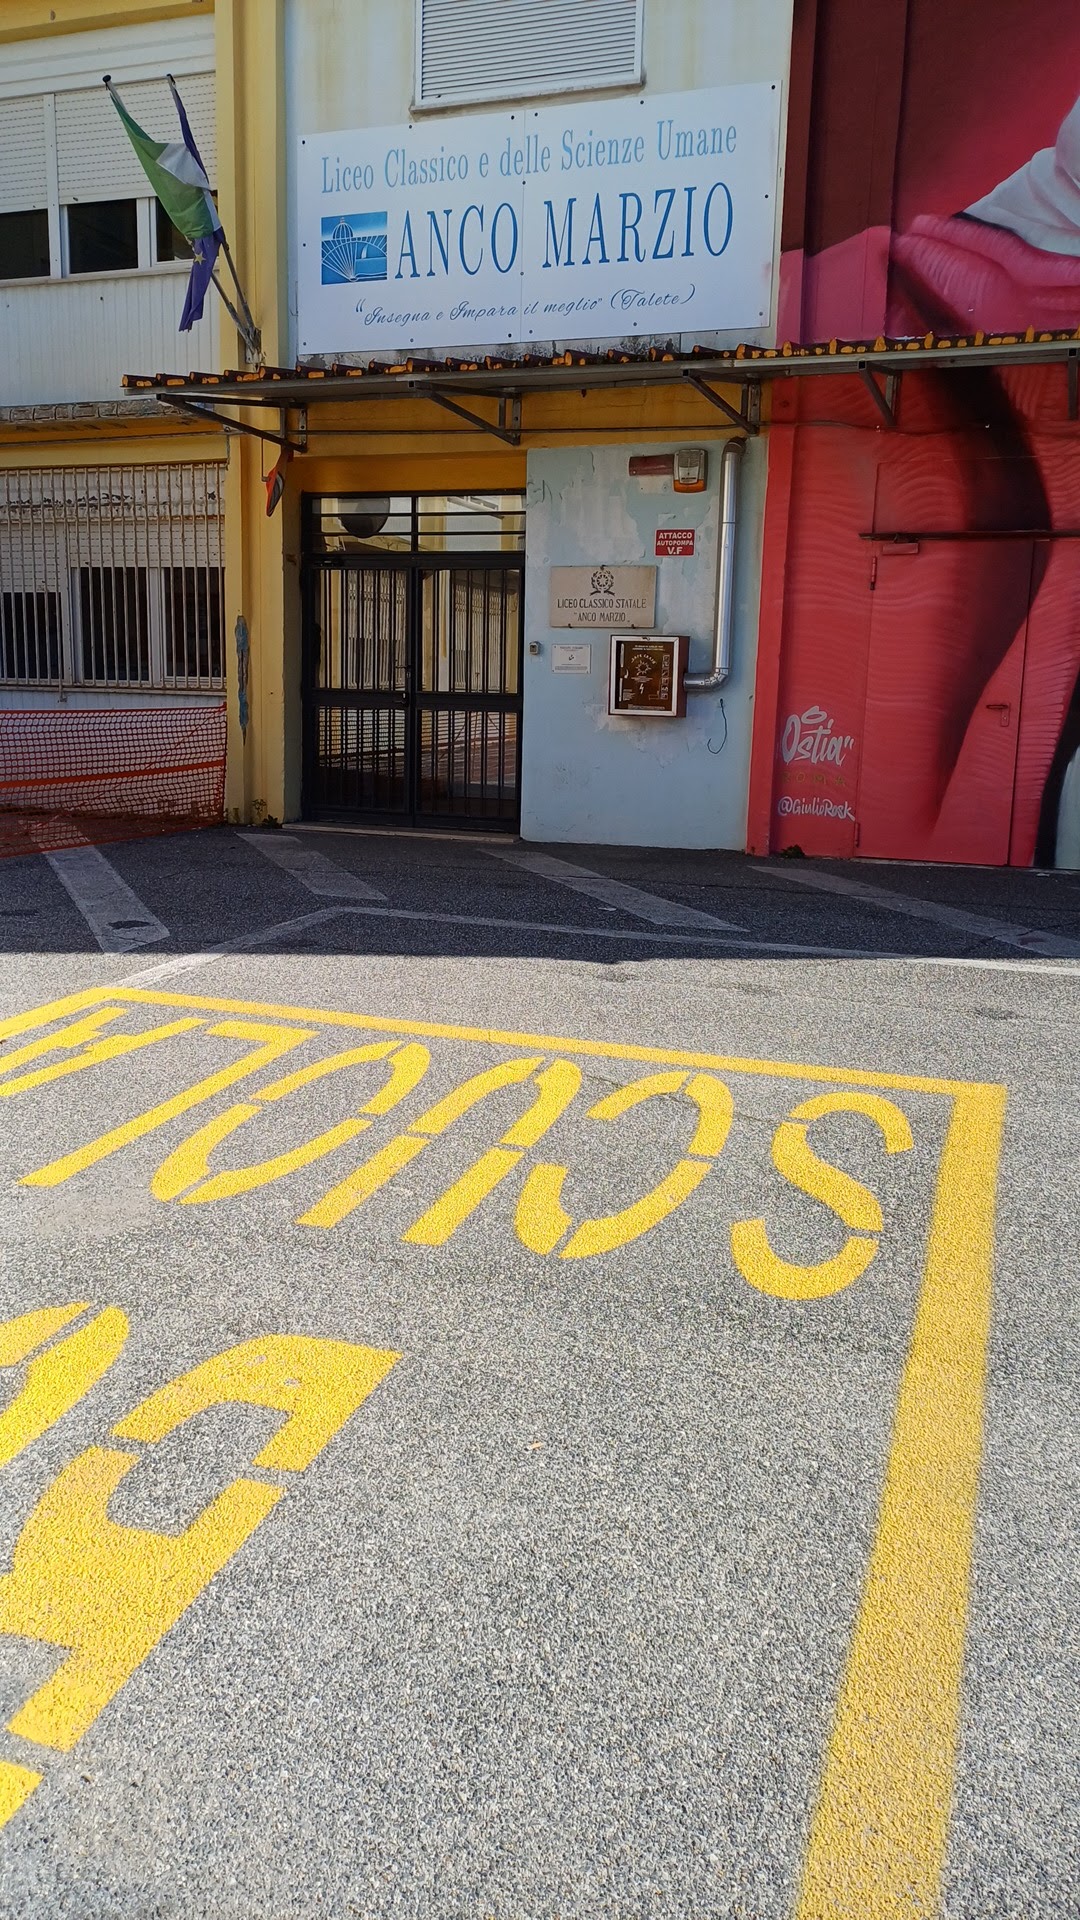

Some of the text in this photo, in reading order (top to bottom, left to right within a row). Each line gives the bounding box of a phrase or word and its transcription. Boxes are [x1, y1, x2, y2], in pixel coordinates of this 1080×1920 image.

[322, 119, 738, 194] Liceo Classico e delle Scienze Umane
[395, 181, 734, 279] ANCO MARZIO
[436, 311, 444, 320] e
[450, 300, 518, 322] Impara
[523, 300, 538, 315] il
[610, 283, 696, 310] (Talete)
[658, 532, 693, 540] ATTACCO
[557, 598, 647, 609] LICEO CLASSICO STATALE
